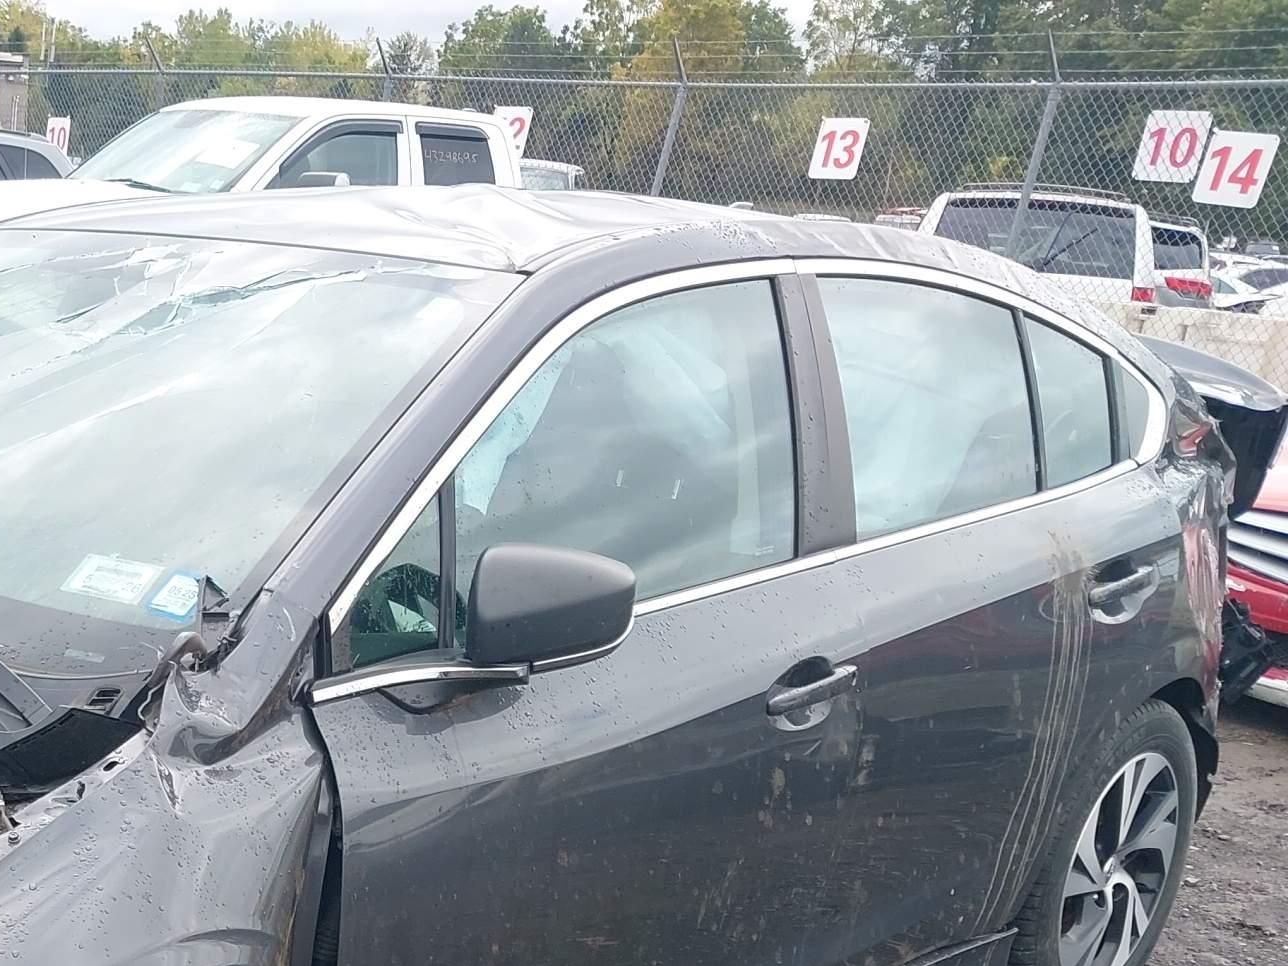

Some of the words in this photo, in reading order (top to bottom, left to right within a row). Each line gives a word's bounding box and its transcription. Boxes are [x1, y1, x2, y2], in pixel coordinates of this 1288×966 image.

[48, 126, 67, 151] 10
[820, 129, 861, 169] 13
[1148, 127, 1198, 169] 10
[1210, 145, 1264, 195] 14
